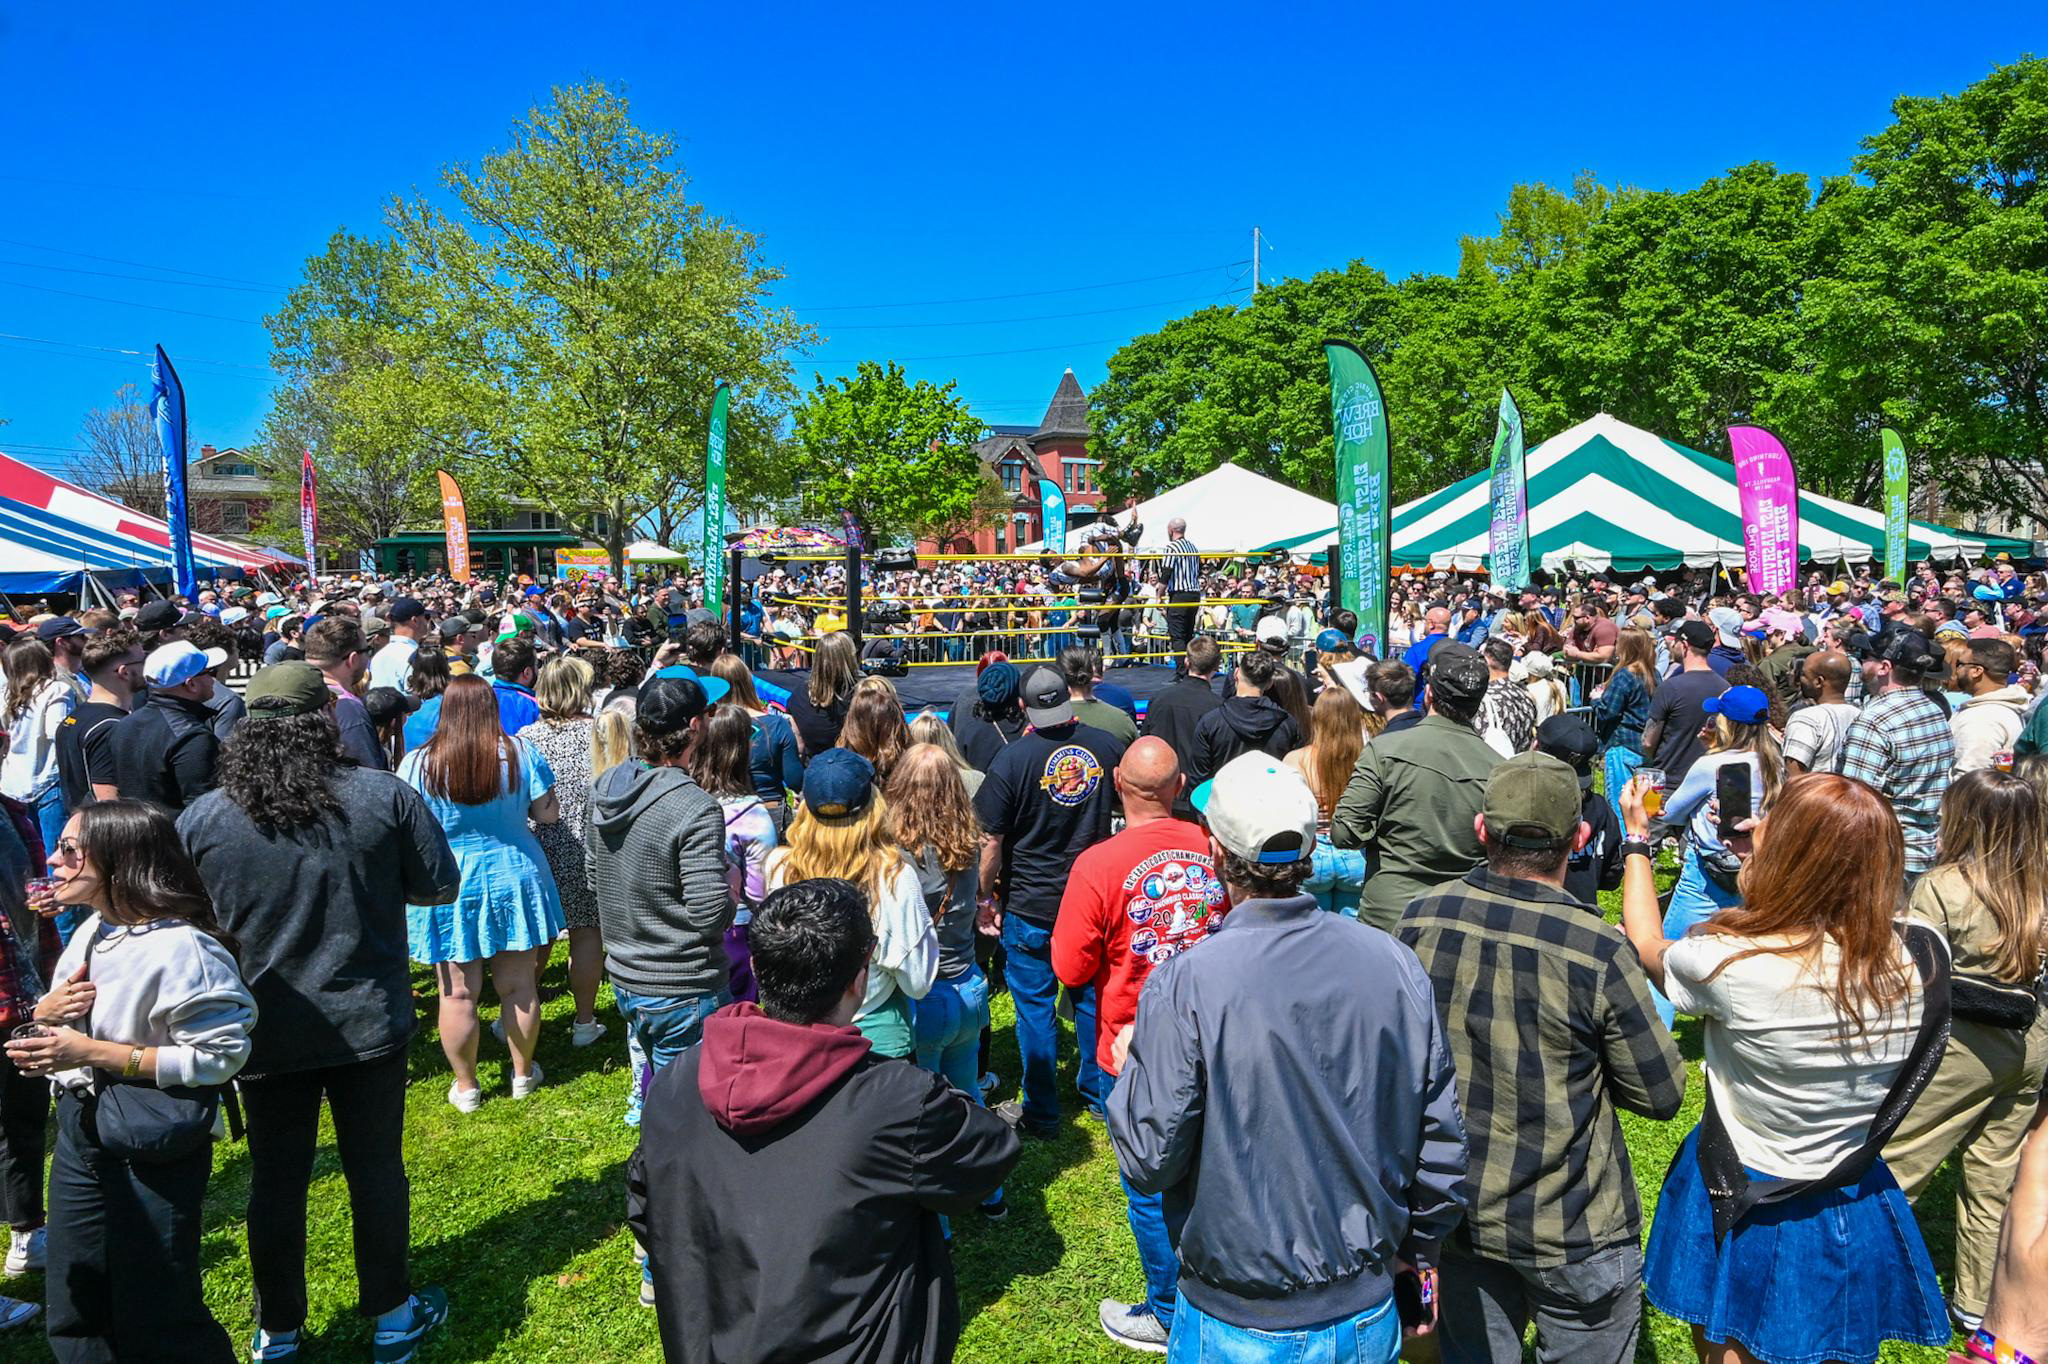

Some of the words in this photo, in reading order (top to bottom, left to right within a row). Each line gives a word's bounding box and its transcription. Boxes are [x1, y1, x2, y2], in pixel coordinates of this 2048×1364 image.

[711, 483, 719, 519] EAST
[708, 523, 718, 603] NASHVILLE
[1048, 748, 1074, 775] CUMMINS
[1075, 749, 1095, 768] CIDER
[1124, 874, 1136, 890] IAC
[1134, 862, 1150, 878] EAST
[1149, 852, 1171, 867] COAST
[1152, 910, 1171, 926] 20
